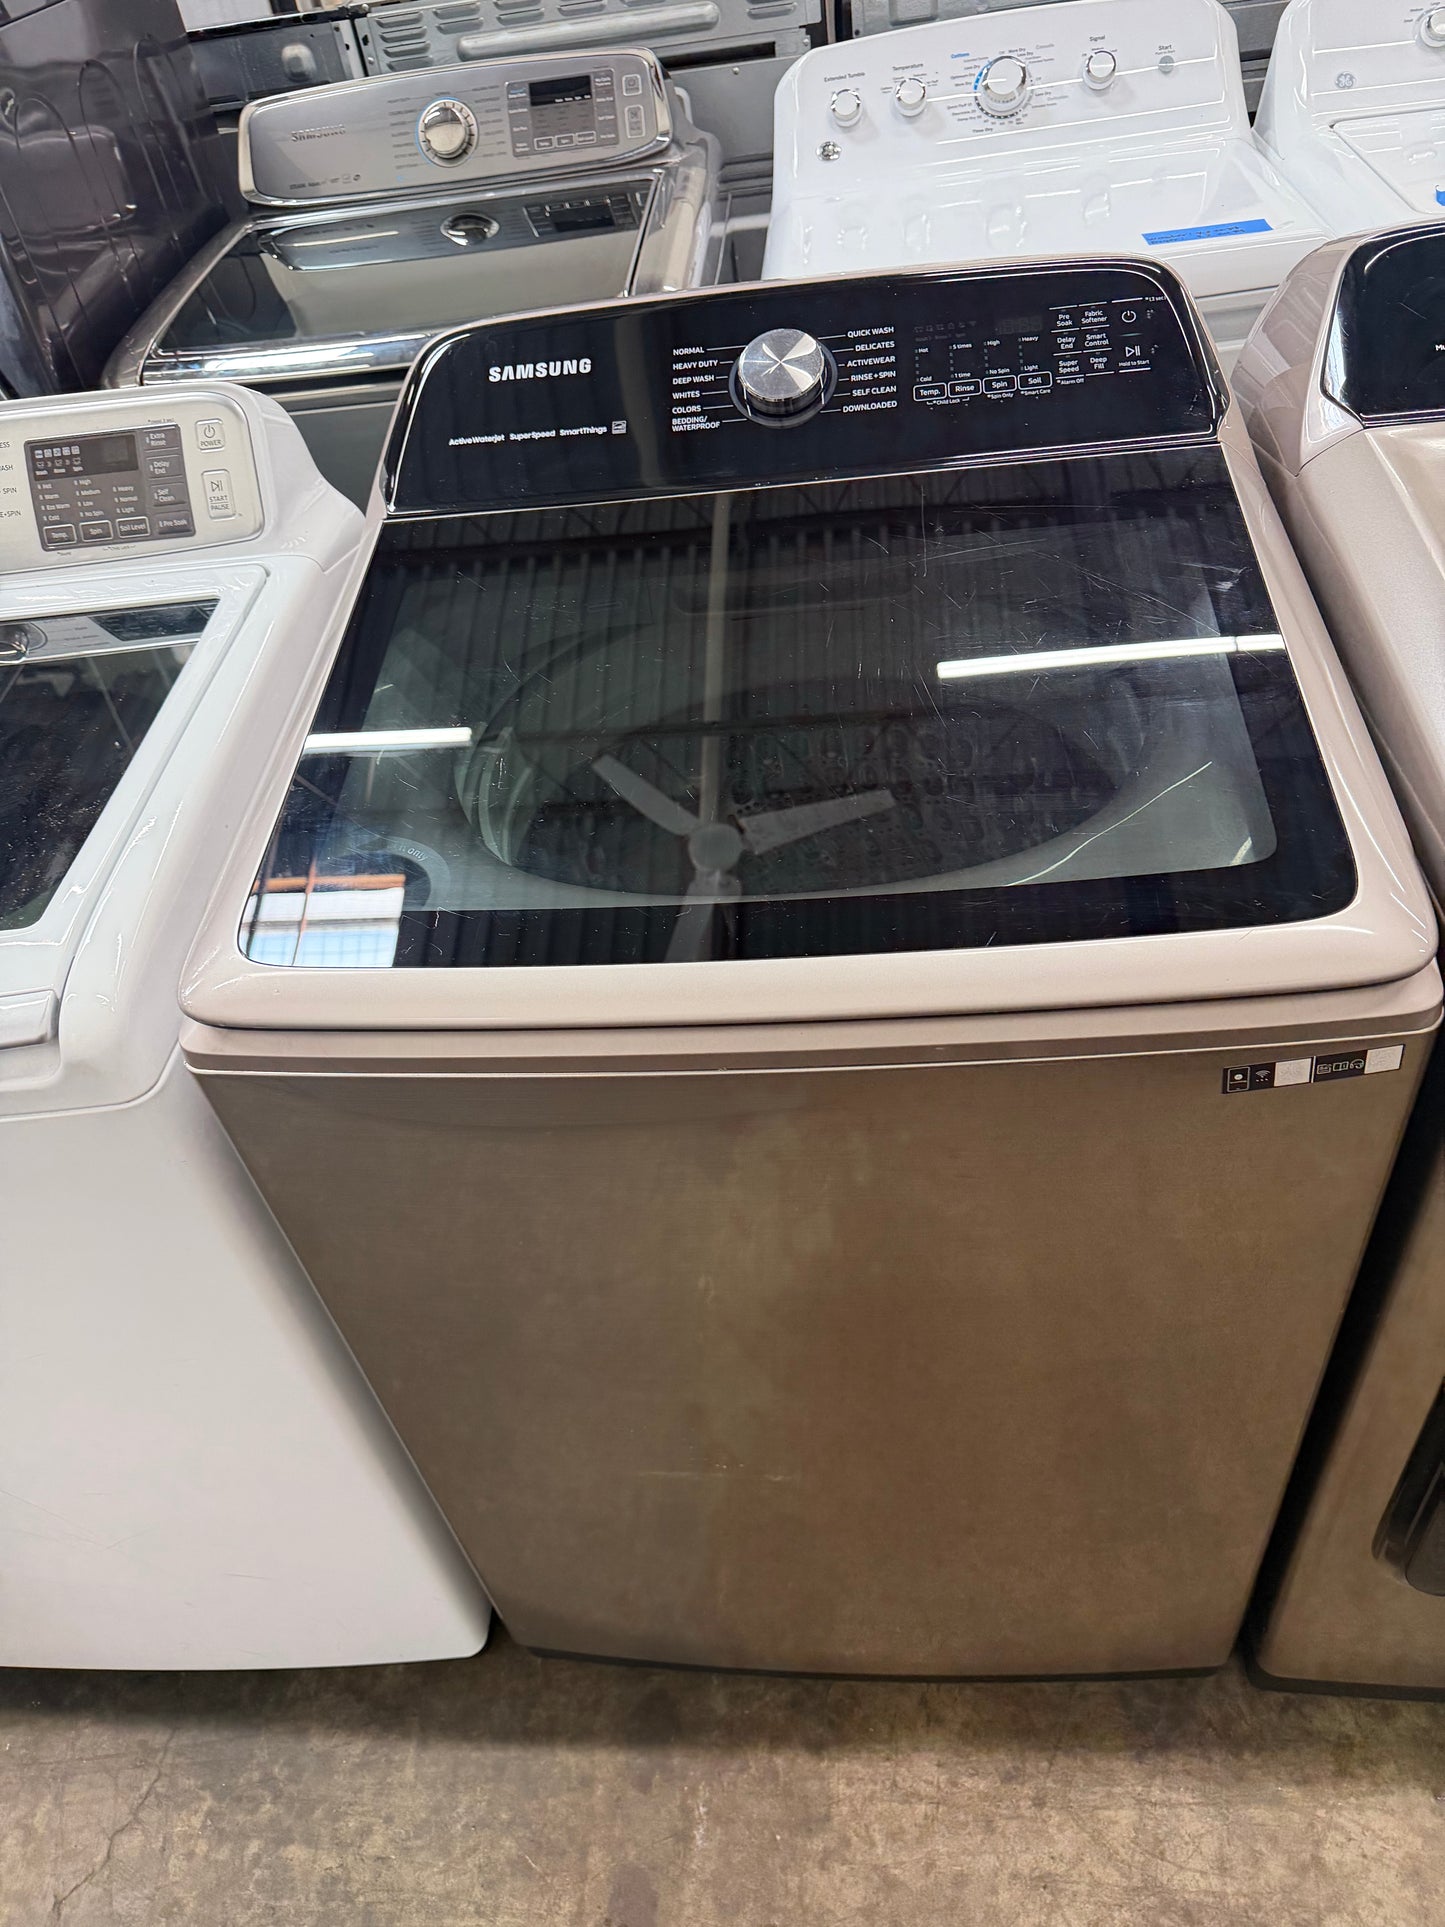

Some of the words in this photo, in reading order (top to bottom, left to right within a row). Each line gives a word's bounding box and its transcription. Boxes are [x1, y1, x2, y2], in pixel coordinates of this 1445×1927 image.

[892, 63, 923, 71] Temperature
[1081, 316, 1108, 324] Softener
[847, 329, 871, 338] QUICK
[872, 326, 894, 335] WASH
[1057, 336, 1076, 344] Delay
[1084, 339, 1109, 347] Control
[855, 341, 895, 351] DELICATES
[673, 347, 704, 355] NORMAL
[672, 362, 697, 370] HEAVY
[698, 360, 718, 368] DUTY
[847, 356, 896, 367] ACTIVEWEAR
[489, 358, 592, 382] SAMSUNG
[1058, 366, 1079, 374] Speed
[673, 377, 691, 385] DEEP
[693, 375, 714, 383] WASH
[1028, 376, 1042, 384] Soil
[955, 385, 975, 393] Rinse
[991, 381, 1008, 389] Spin
[672, 391, 700, 399] WHITES
[852, 388, 870, 396] SELF
[871, 385, 897, 394] CLEAN
[920, 388, 940, 397] Temp.
[672, 405, 701, 414] COLORS
[843, 400, 897, 412] DOWNLOADED
[672, 416, 708, 425] BEDDING/
[672, 421, 720, 432] WATERPROOF
[509, 430, 556, 441] SuperSpeed
[559, 426, 607, 437] SmartThings
[200, 439, 222, 447] POWER
[407, 847, 428, 861] only
